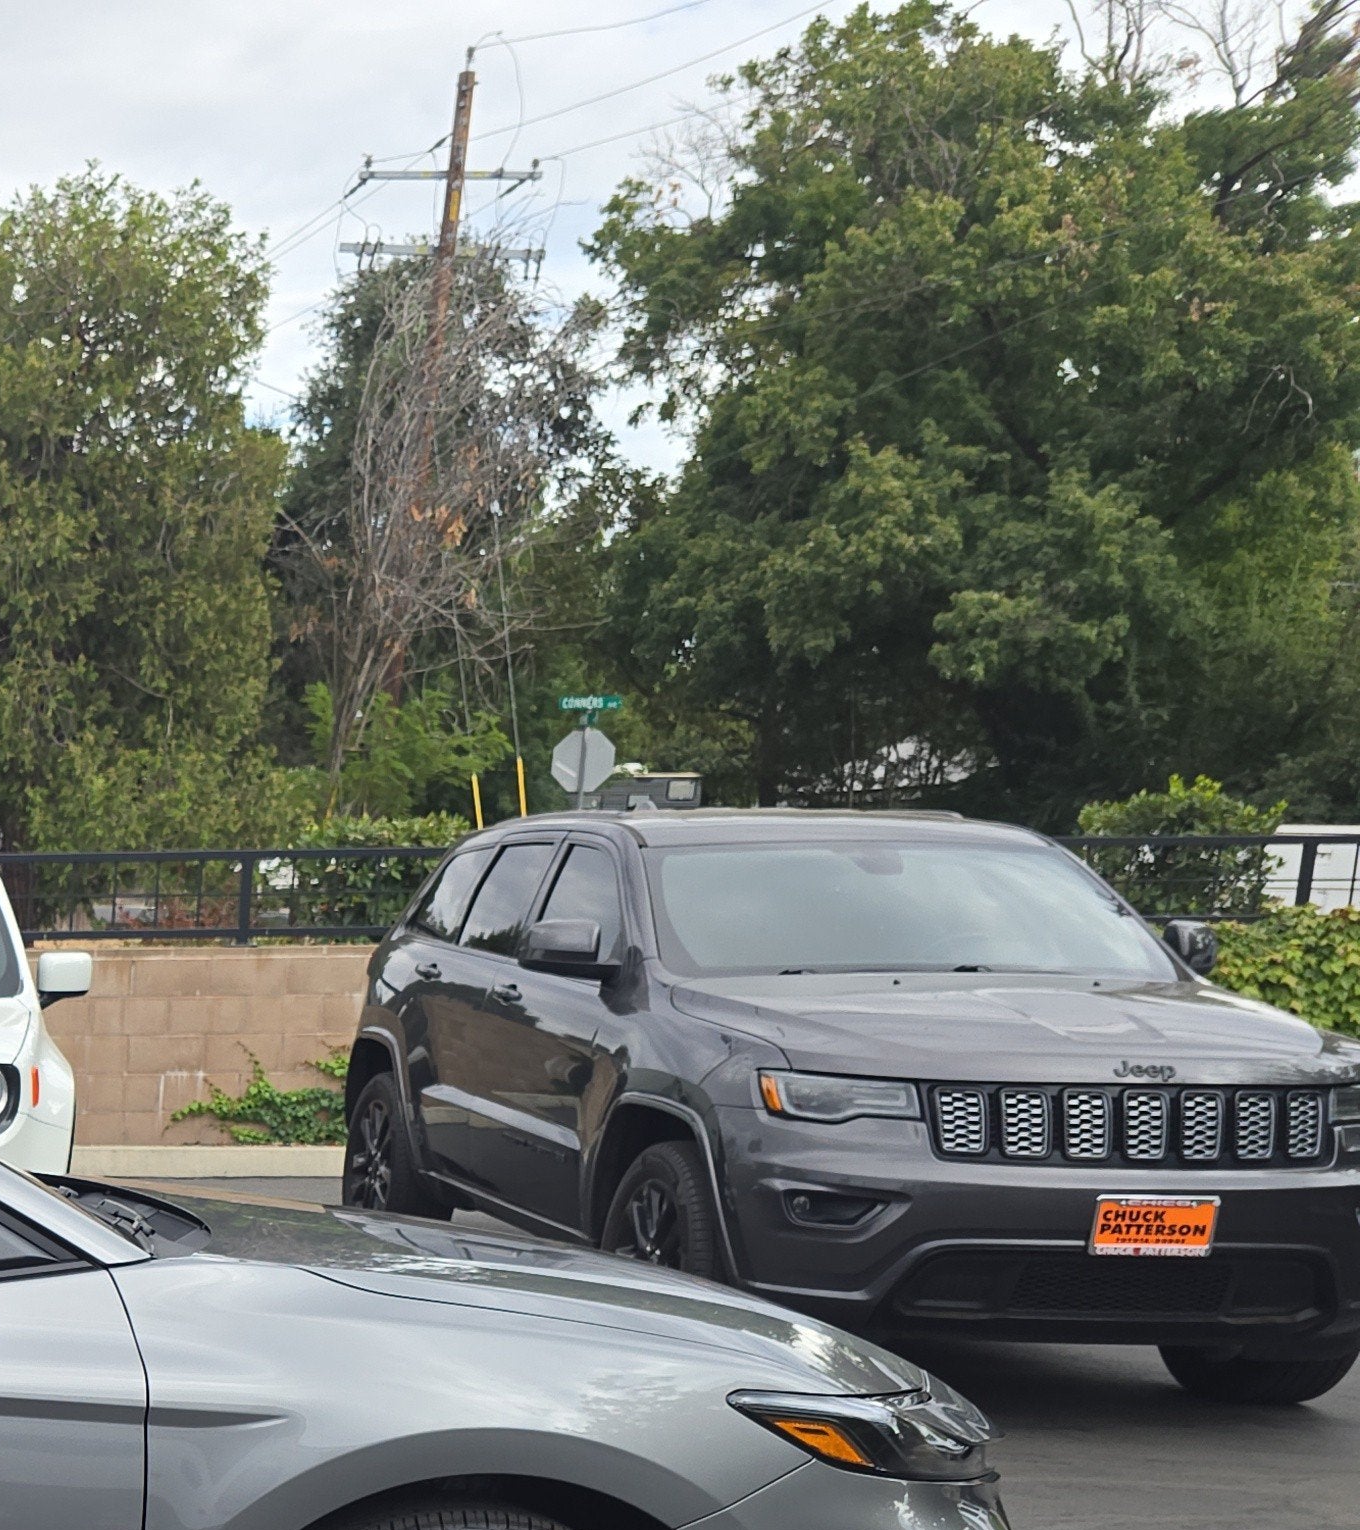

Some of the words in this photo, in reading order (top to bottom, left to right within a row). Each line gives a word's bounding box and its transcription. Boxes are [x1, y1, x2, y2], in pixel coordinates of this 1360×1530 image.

[1112, 1060, 1177, 1083] Jeep
[1102, 1209, 1167, 1223] CHUCK
[1099, 1223, 1207, 1237] PATTERSON
